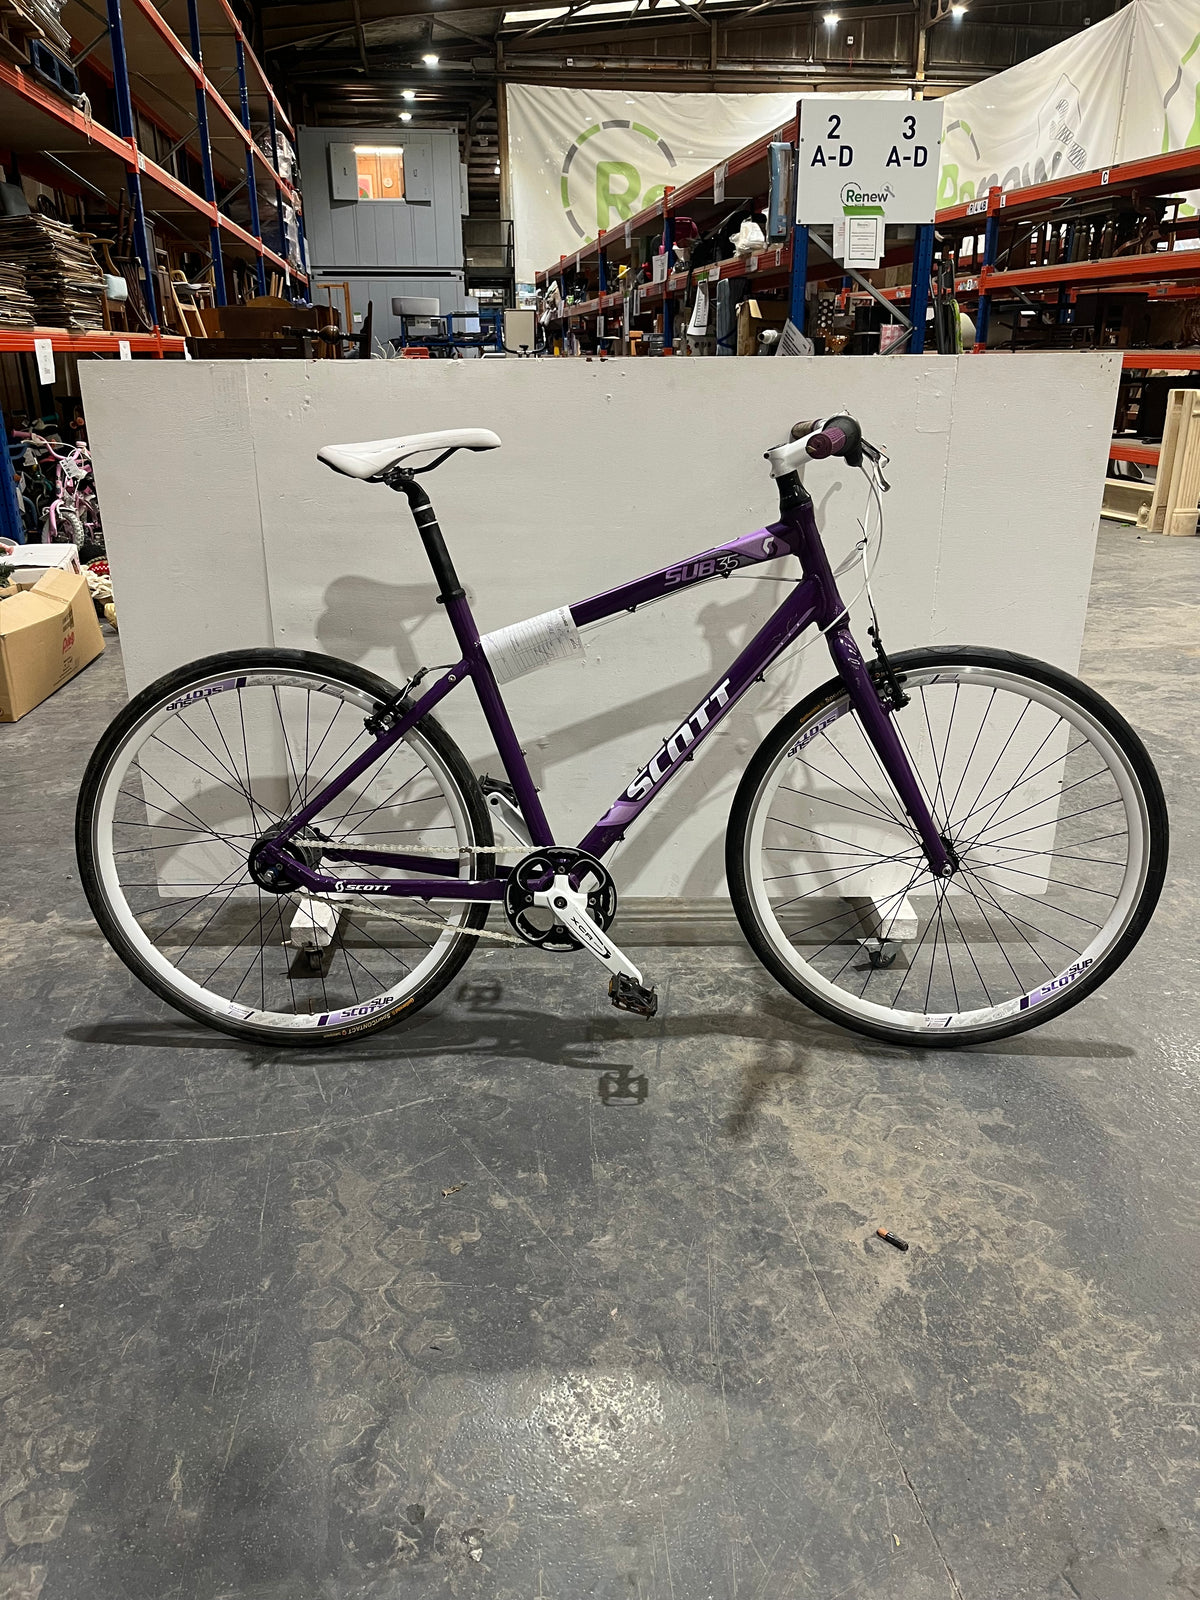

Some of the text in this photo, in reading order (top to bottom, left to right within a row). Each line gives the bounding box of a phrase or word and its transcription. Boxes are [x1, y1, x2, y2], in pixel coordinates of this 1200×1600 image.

[826, 114, 841, 139] 2
[902, 115, 916, 140] 3
[810, 145, 853, 167] A-D
[885, 145, 928, 167] A-D
[846, 189, 888, 203] Renew
[664, 553, 740, 587] SUB 35
[626, 677, 731, 801] SCOTT
[570, 916, 593, 941] XCR
